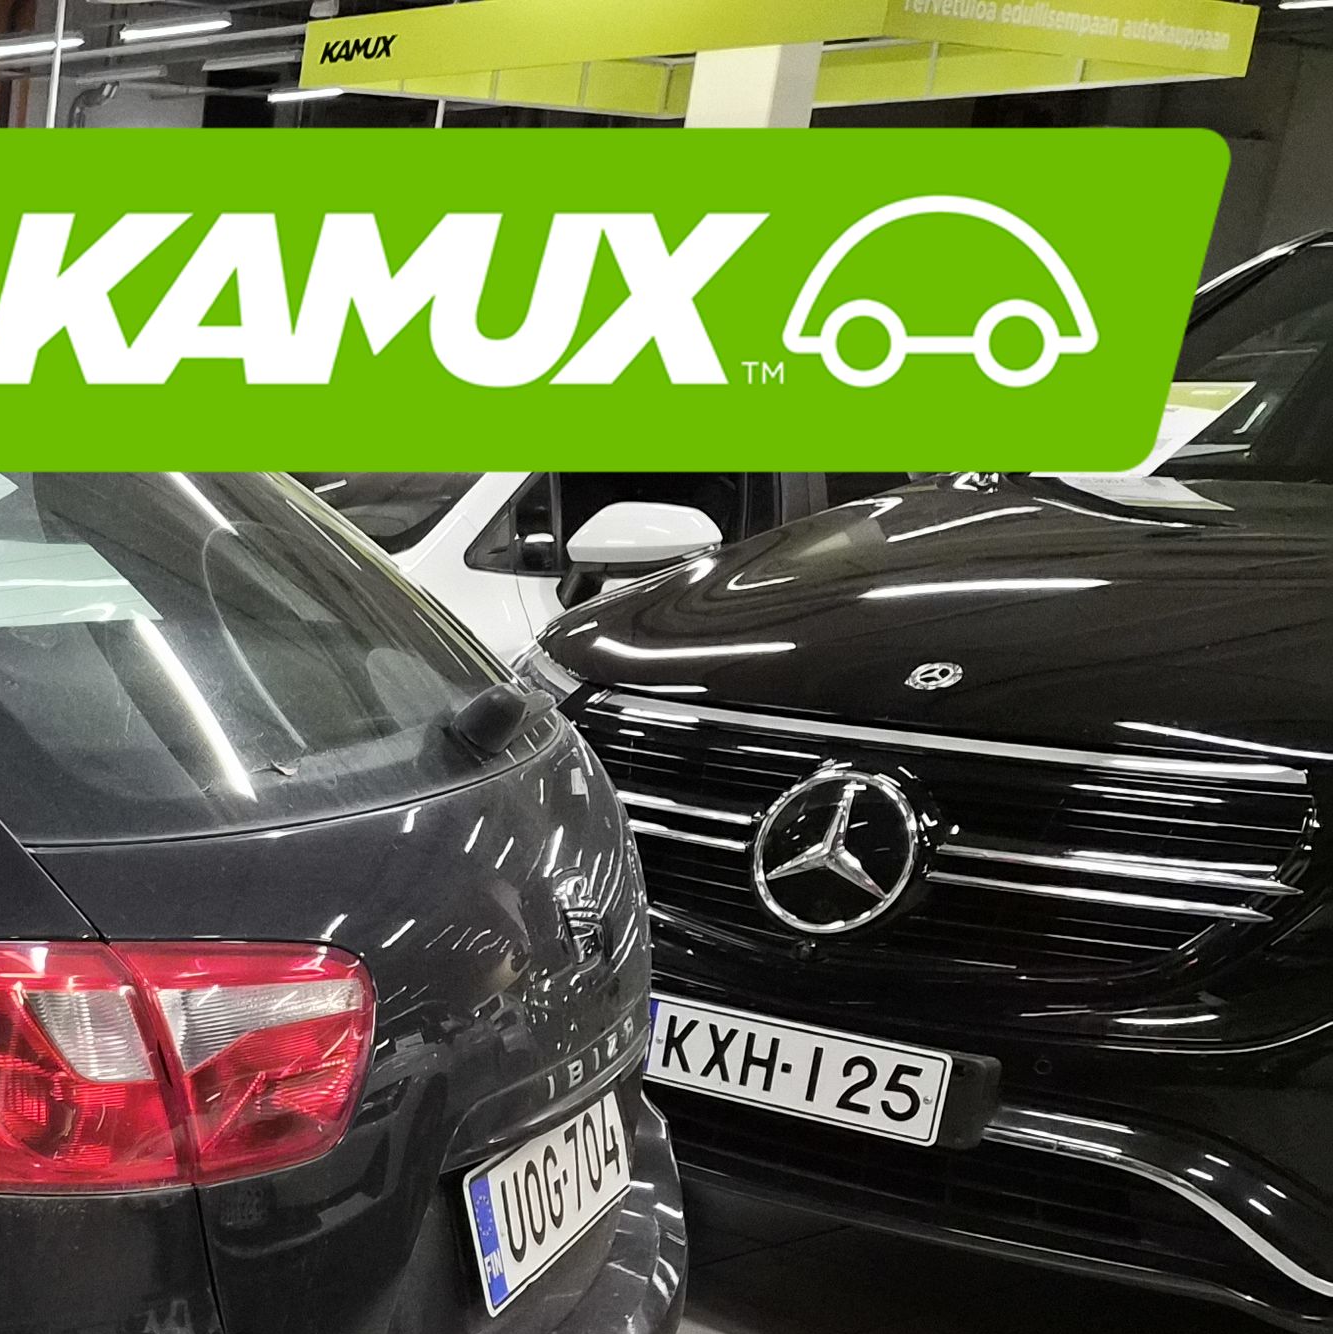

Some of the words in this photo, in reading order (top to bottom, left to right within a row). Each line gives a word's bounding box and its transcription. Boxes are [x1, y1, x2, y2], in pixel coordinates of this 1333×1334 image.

[319, 34, 398, 65] KAMUX
[546, 1015, 635, 1100] IBIZA
[661, 1014, 924, 1122] KXH-125
[500, 1099, 621, 1263] UOG-704
[484, 1247, 504, 1284] FIN
